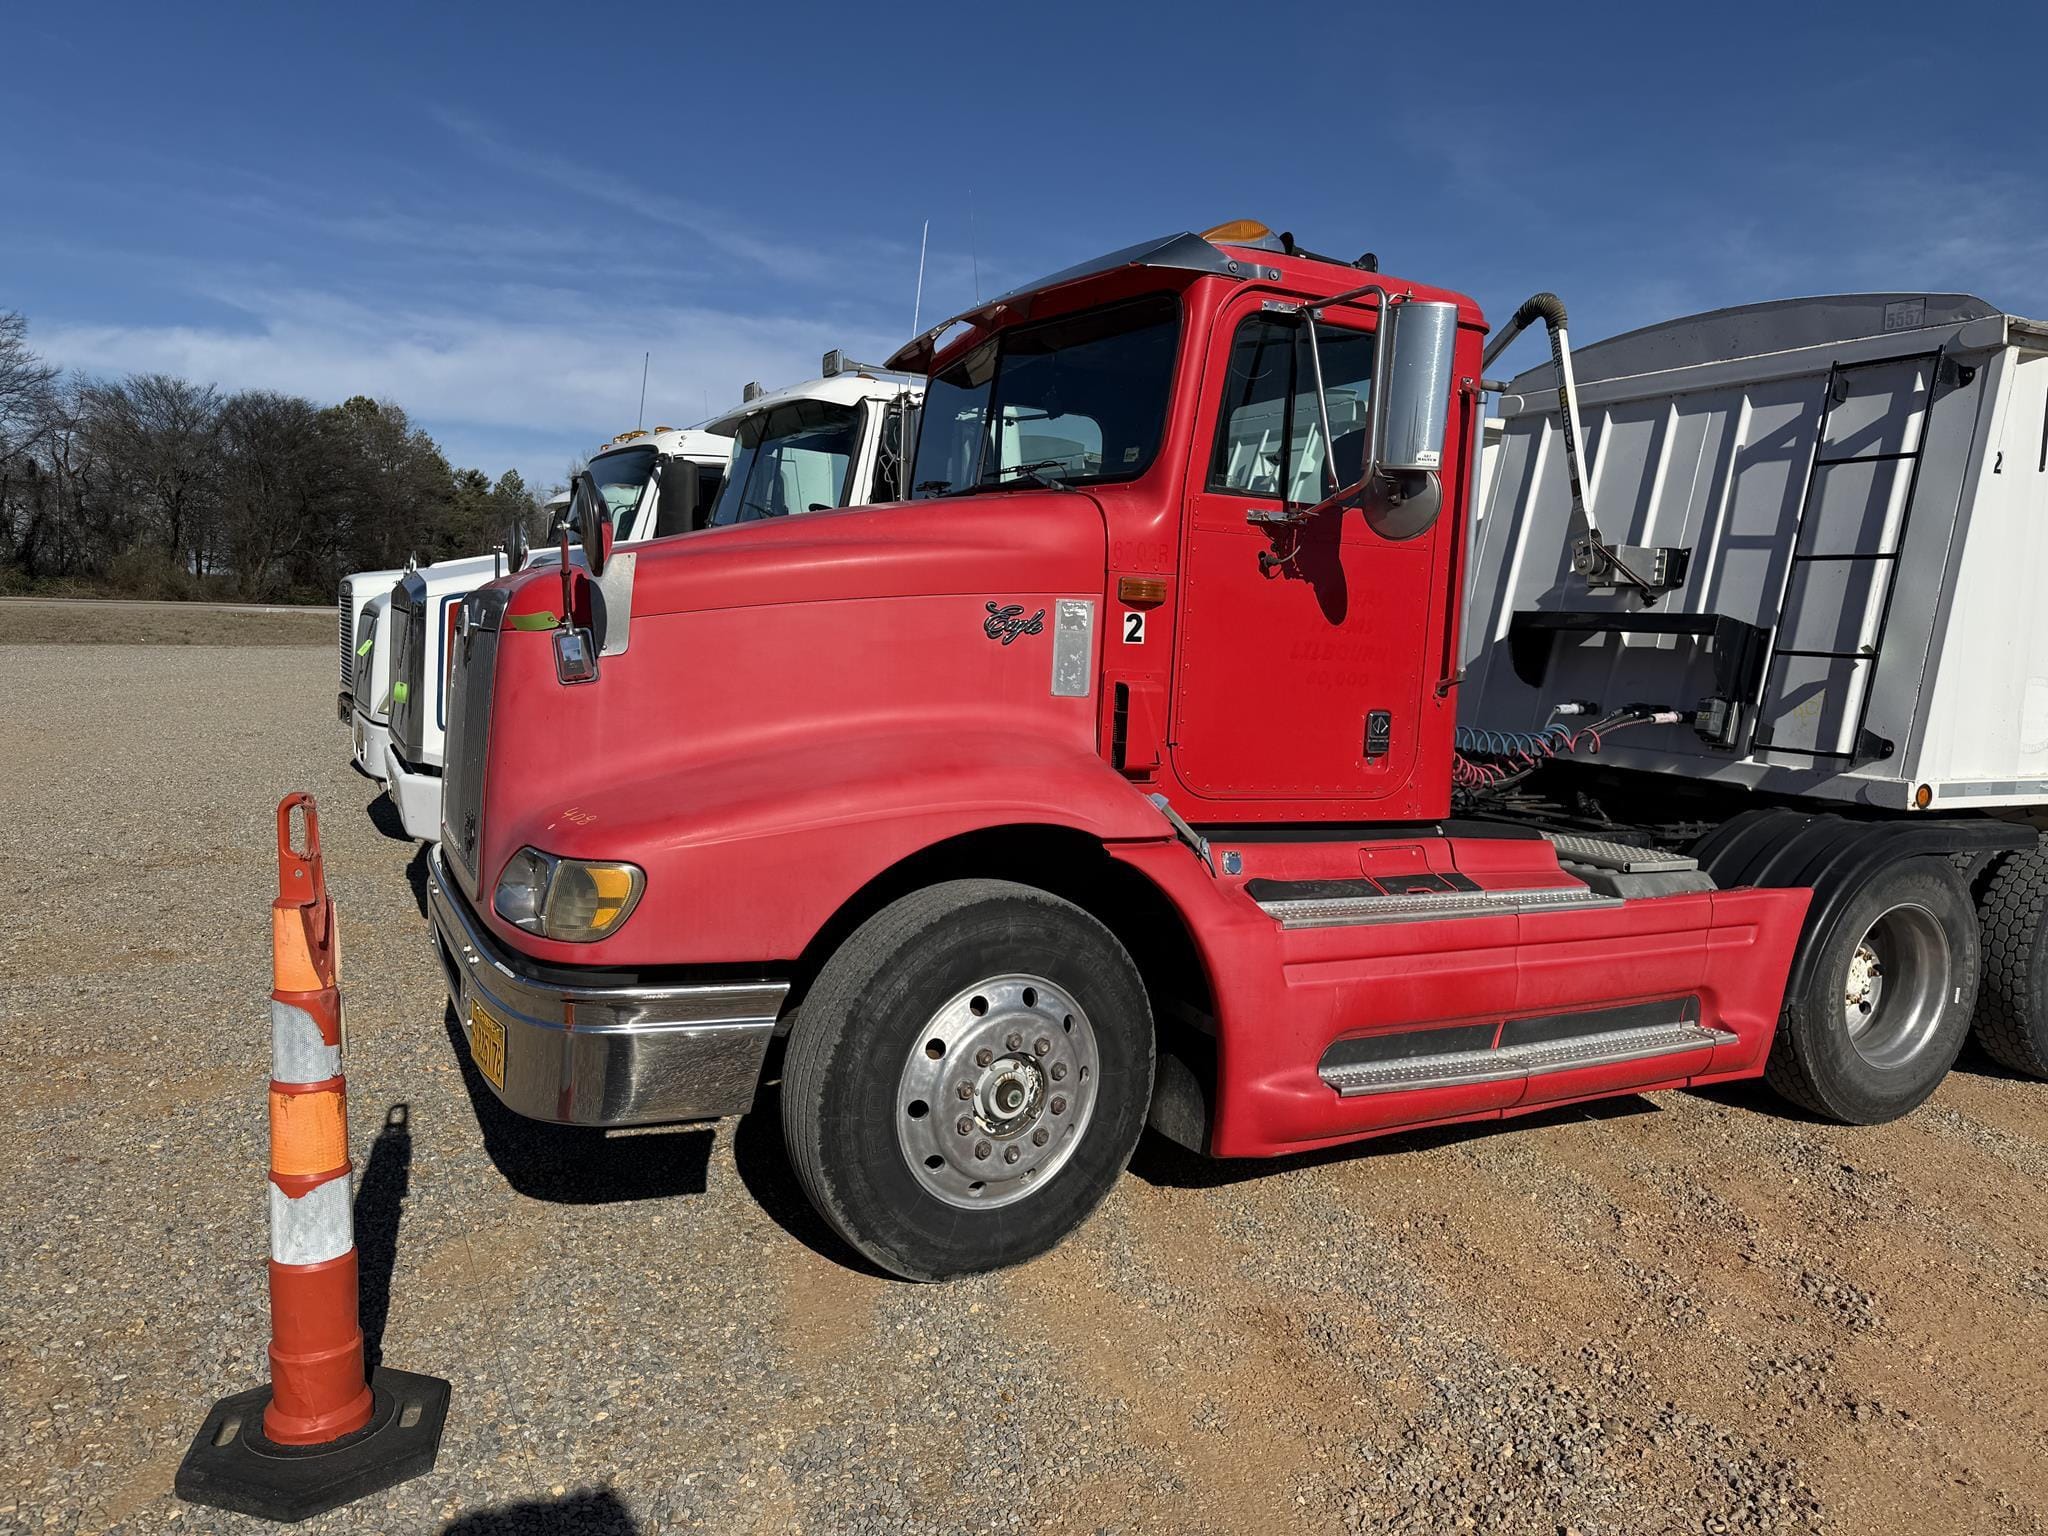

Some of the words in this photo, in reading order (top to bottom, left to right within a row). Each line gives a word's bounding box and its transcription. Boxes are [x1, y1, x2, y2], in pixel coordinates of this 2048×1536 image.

[1886, 309, 1923, 329] 5557
[1993, 451, 2003, 474] 2
[984, 601, 1045, 645] Eagle
[1125, 613, 1144, 643] 2
[561, 806, 598, 826] 408
